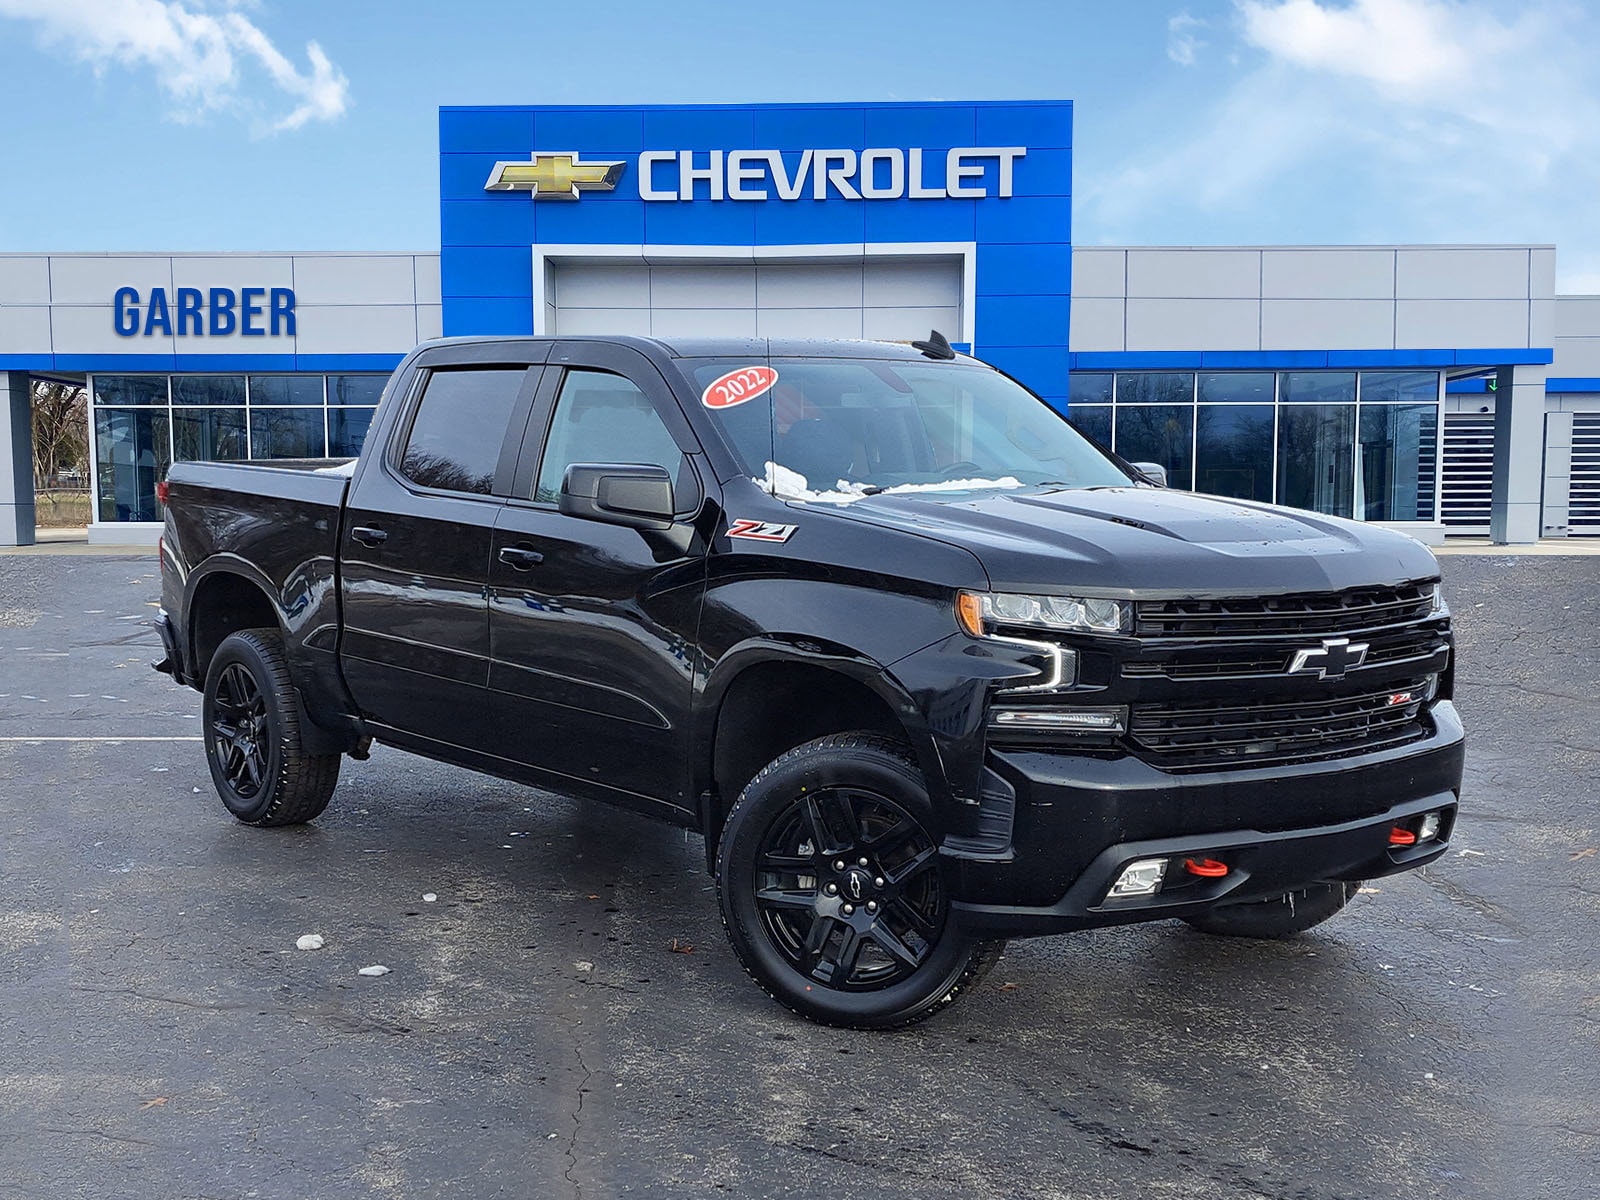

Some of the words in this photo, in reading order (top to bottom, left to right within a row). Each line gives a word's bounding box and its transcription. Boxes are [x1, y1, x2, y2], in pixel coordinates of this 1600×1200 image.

[638, 147, 1027, 202] CHEVROLET
[114, 286, 297, 336] GARBER
[716, 369, 766, 403] 2022
[724, 519, 799, 543] Z71
